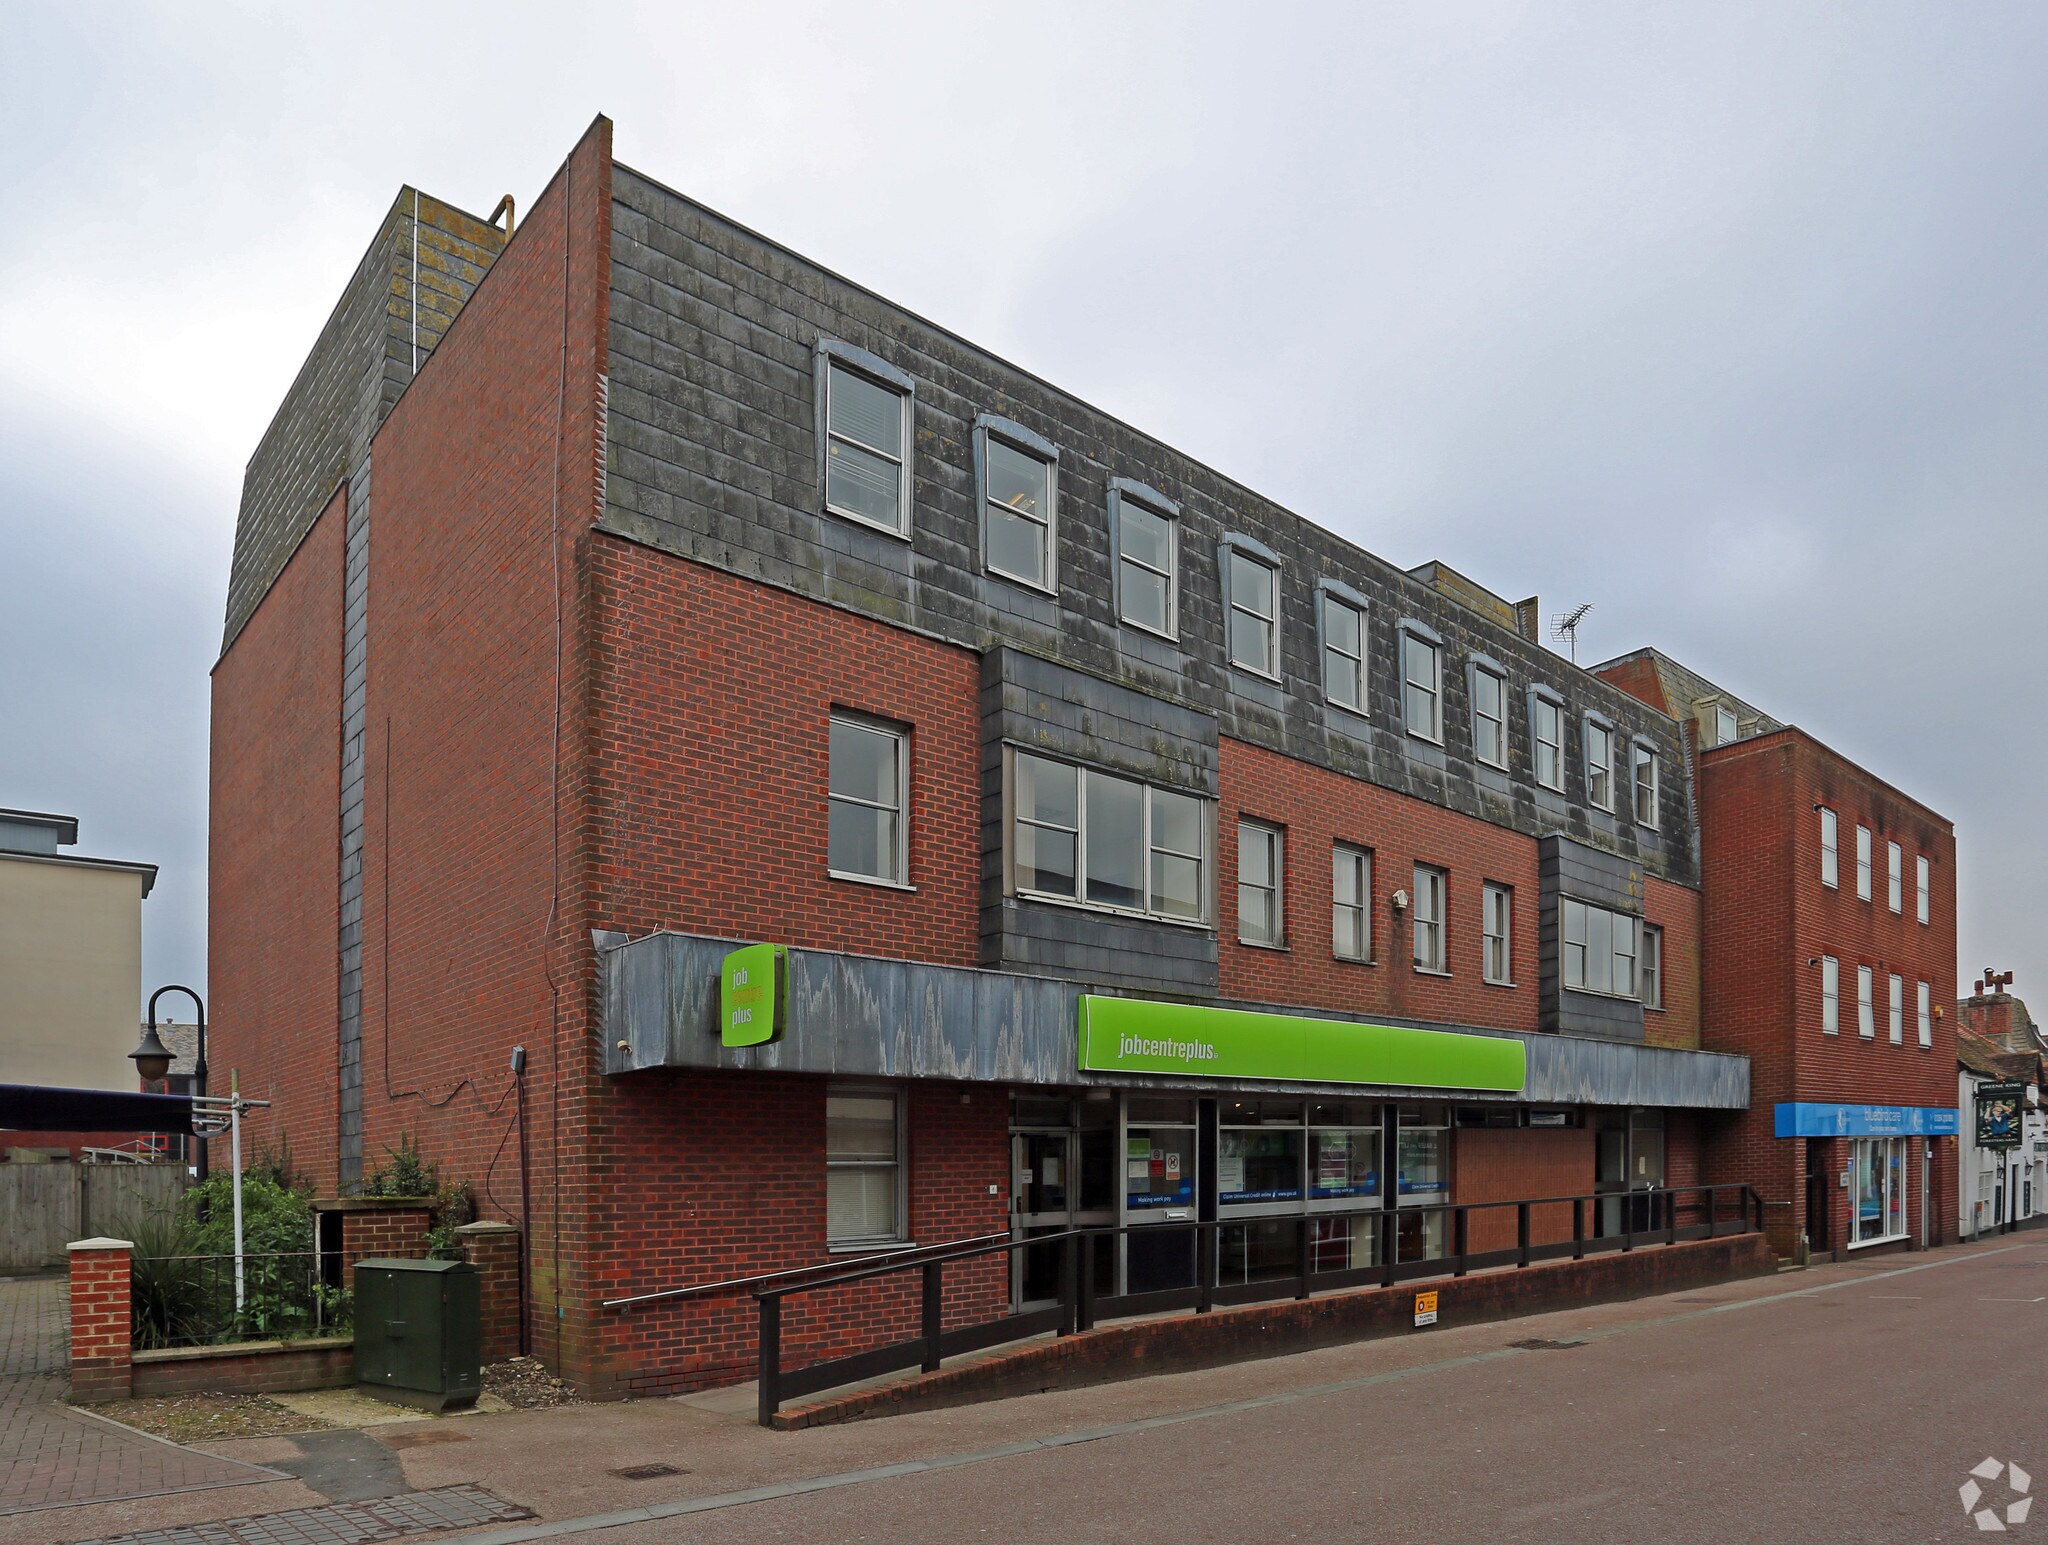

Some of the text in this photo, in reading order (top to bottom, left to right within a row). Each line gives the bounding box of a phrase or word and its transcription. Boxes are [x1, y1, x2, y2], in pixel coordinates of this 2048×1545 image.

[732, 967, 748, 990] job
[732, 1007, 752, 1029] plus
[1118, 1032, 1214, 1063] jobcentreplus
[1864, 1108, 1888, 1121] bluebird
[1889, 1111, 1901, 1121] care
